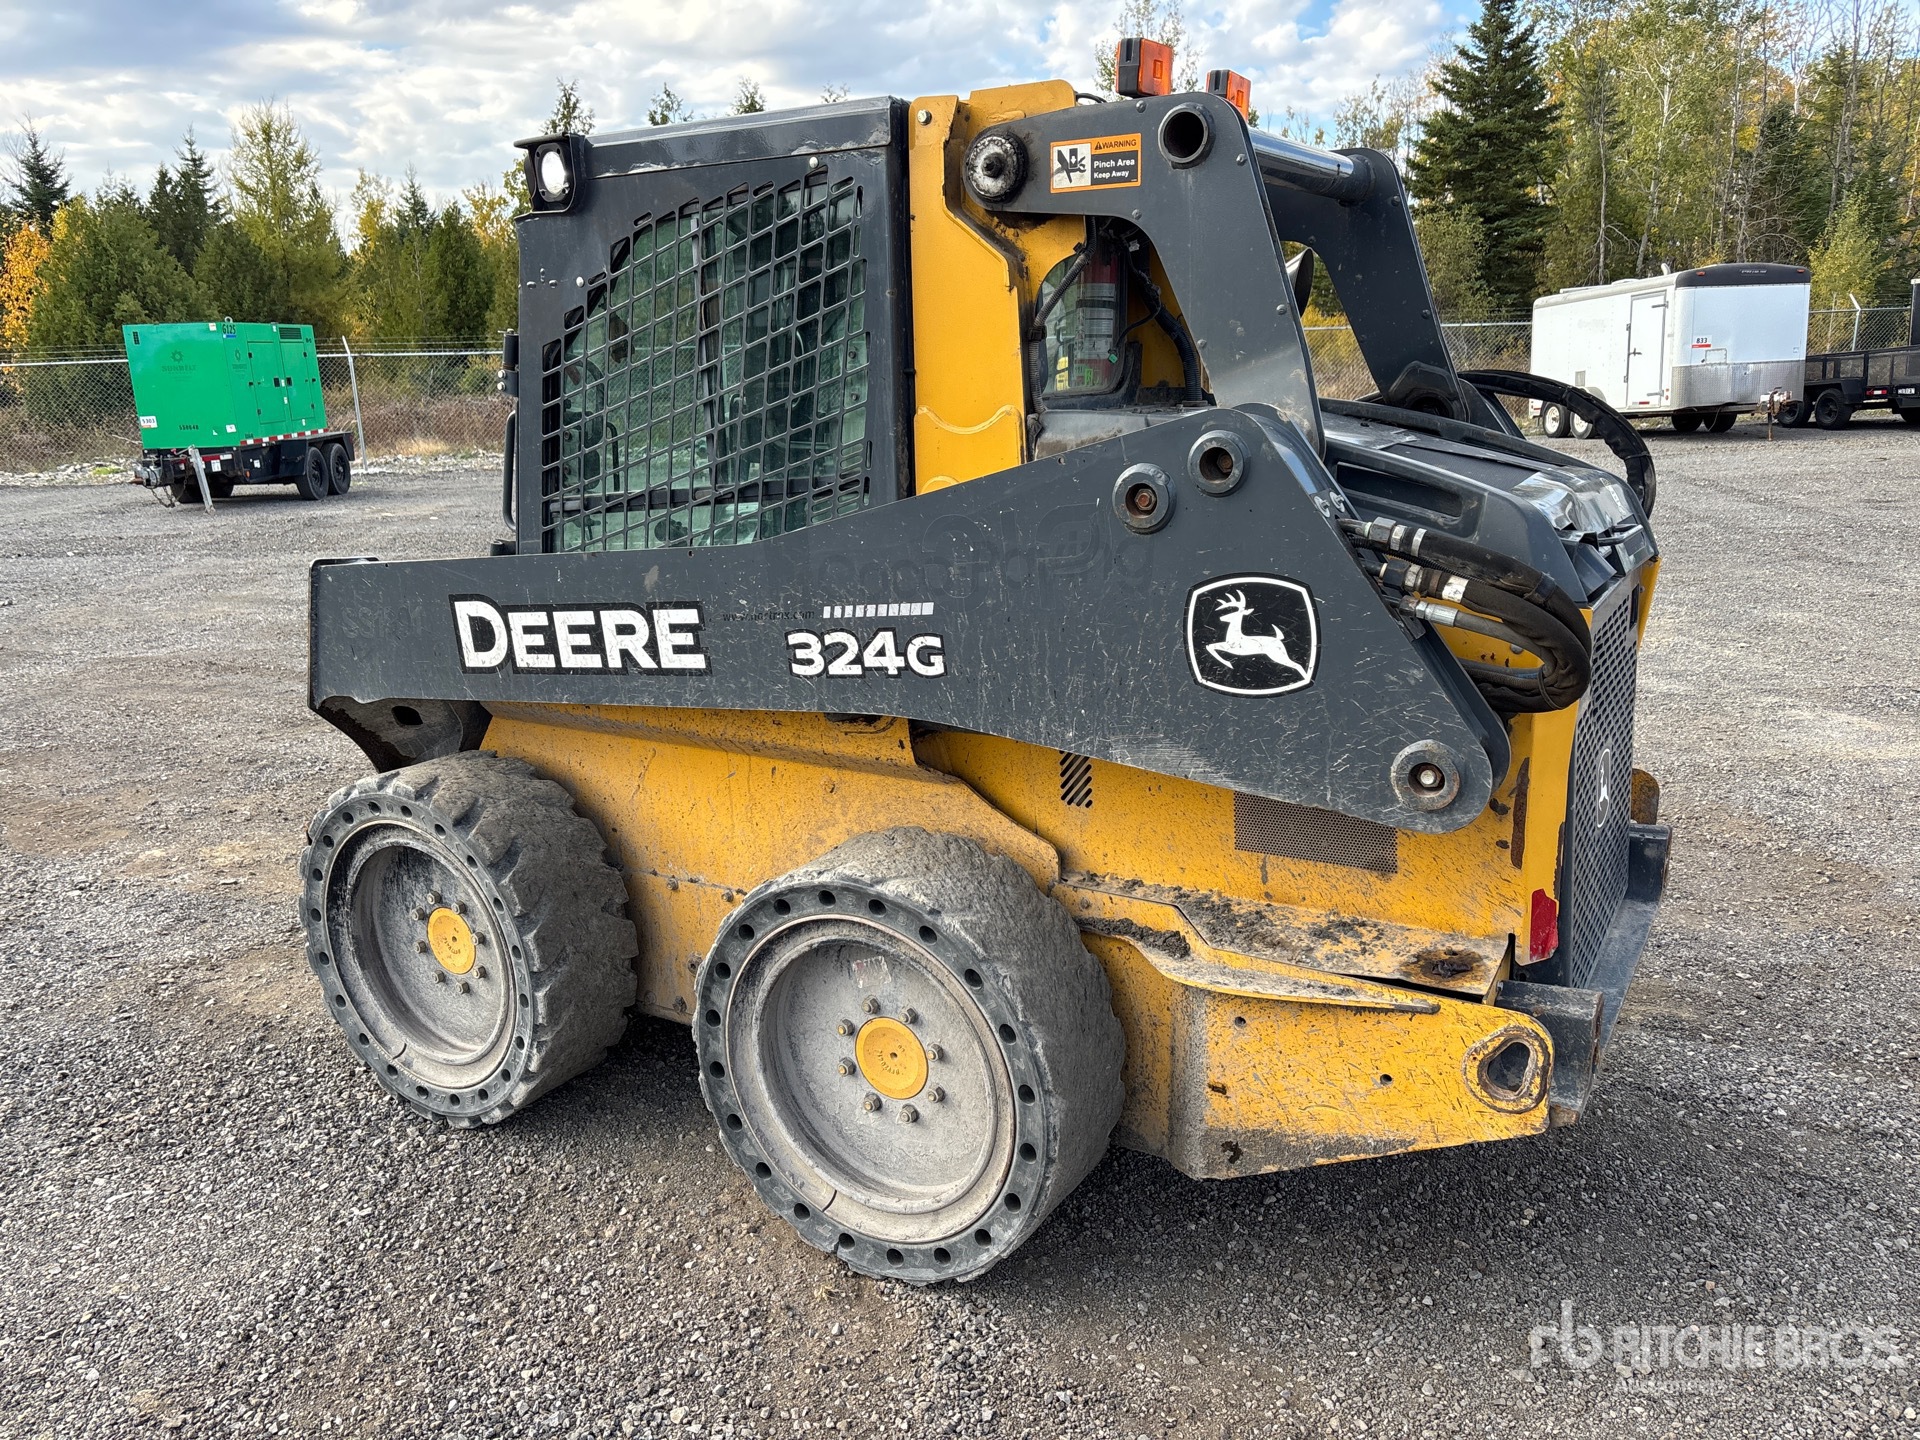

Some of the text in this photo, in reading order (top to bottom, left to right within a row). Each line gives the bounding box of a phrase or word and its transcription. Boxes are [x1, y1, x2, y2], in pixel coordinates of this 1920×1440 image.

[1102, 139, 1136, 149] WARNING
[1093, 158, 1135, 169] Pinch Area
[1111, 170, 1129, 178] Away
[452, 596, 708, 674] DEERE
[786, 629, 946, 678] 324G
